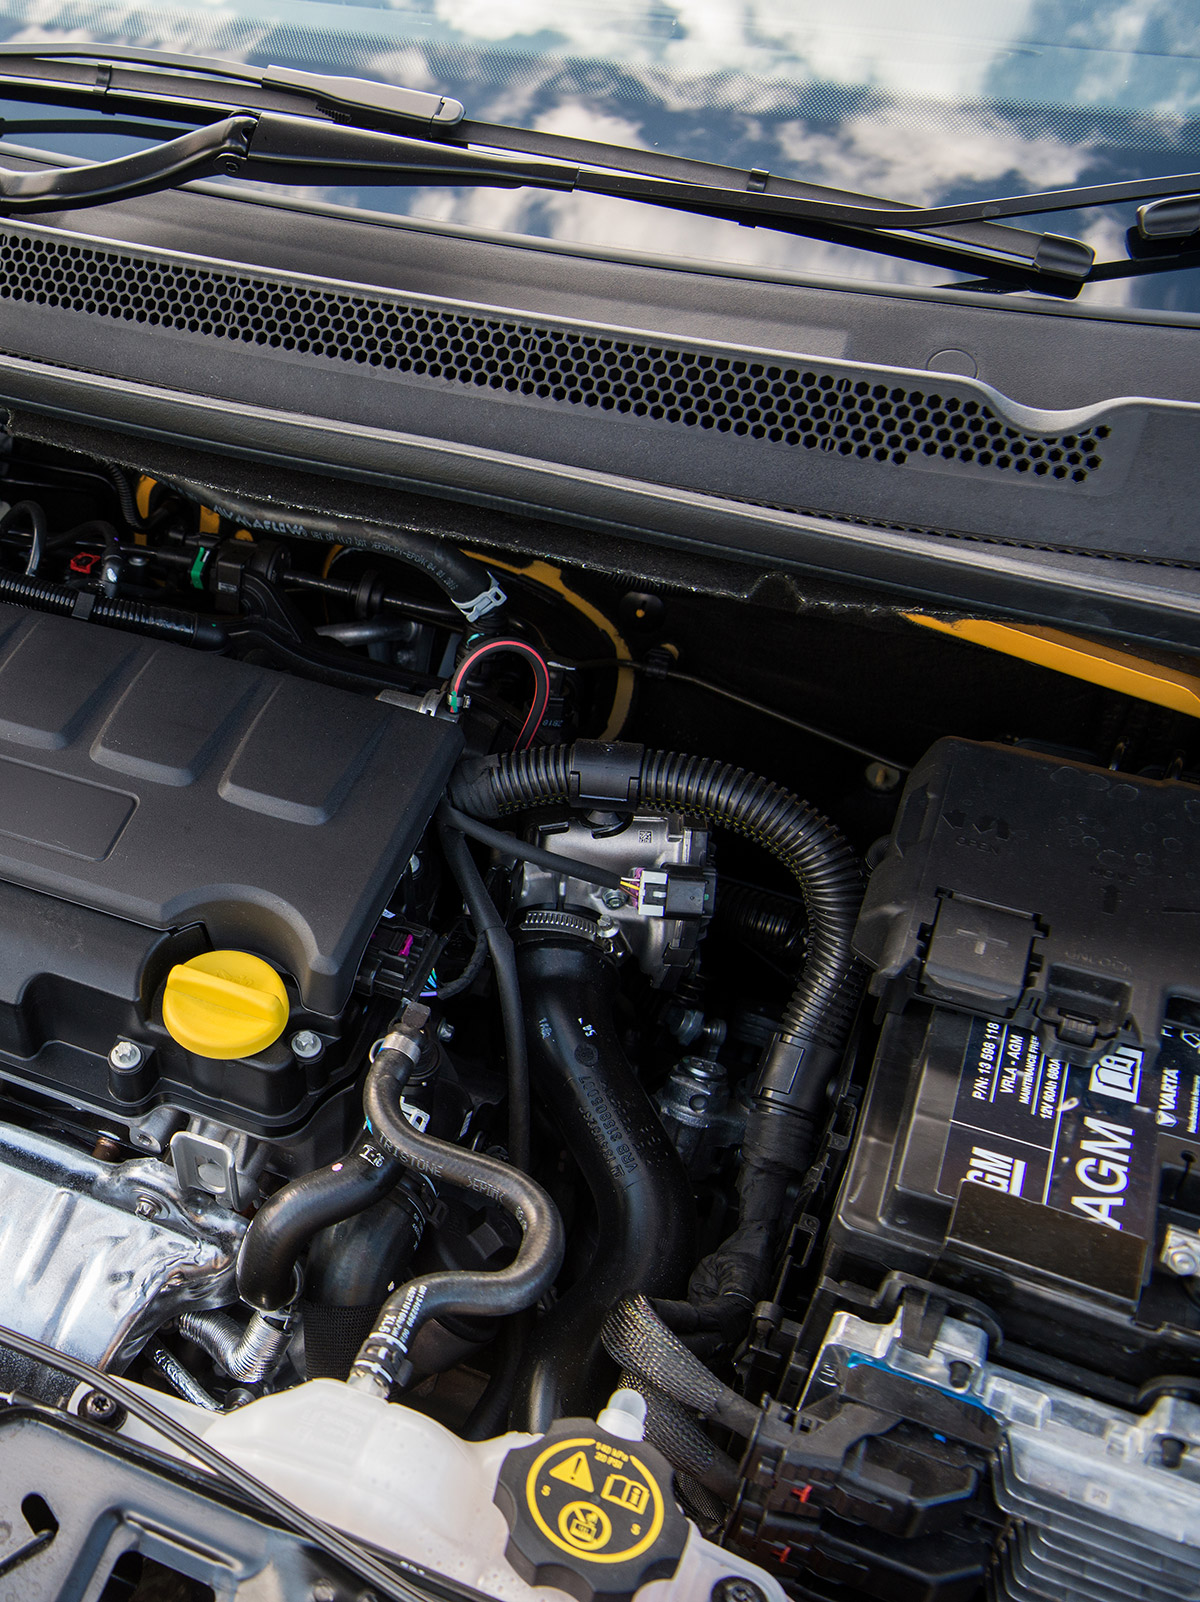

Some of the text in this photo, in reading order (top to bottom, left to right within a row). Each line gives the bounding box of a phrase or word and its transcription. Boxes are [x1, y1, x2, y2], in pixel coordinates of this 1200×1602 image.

[1007, 1034, 1025, 1060] AGM
[972, 1022, 1000, 1100] P/N: 13 598 118
[1000, 1068, 1018, 1093] VRLA
[1019, 1054, 1039, 1105] MAINTENANCE
[1043, 1080, 1059, 1103] 60Ah
[1158, 1069, 1181, 1110] VARTA
[1040, 1101, 1055, 1119] 12V
[379, 1131, 443, 1177] TRISTONE
[616, 1143, 638, 1173] VRB
[1071, 1116, 1135, 1230] AGM
[378, 1313, 397, 1333] XLG
[541, 1484, 551, 1496] S
[630, 1523, 641, 1536] S
